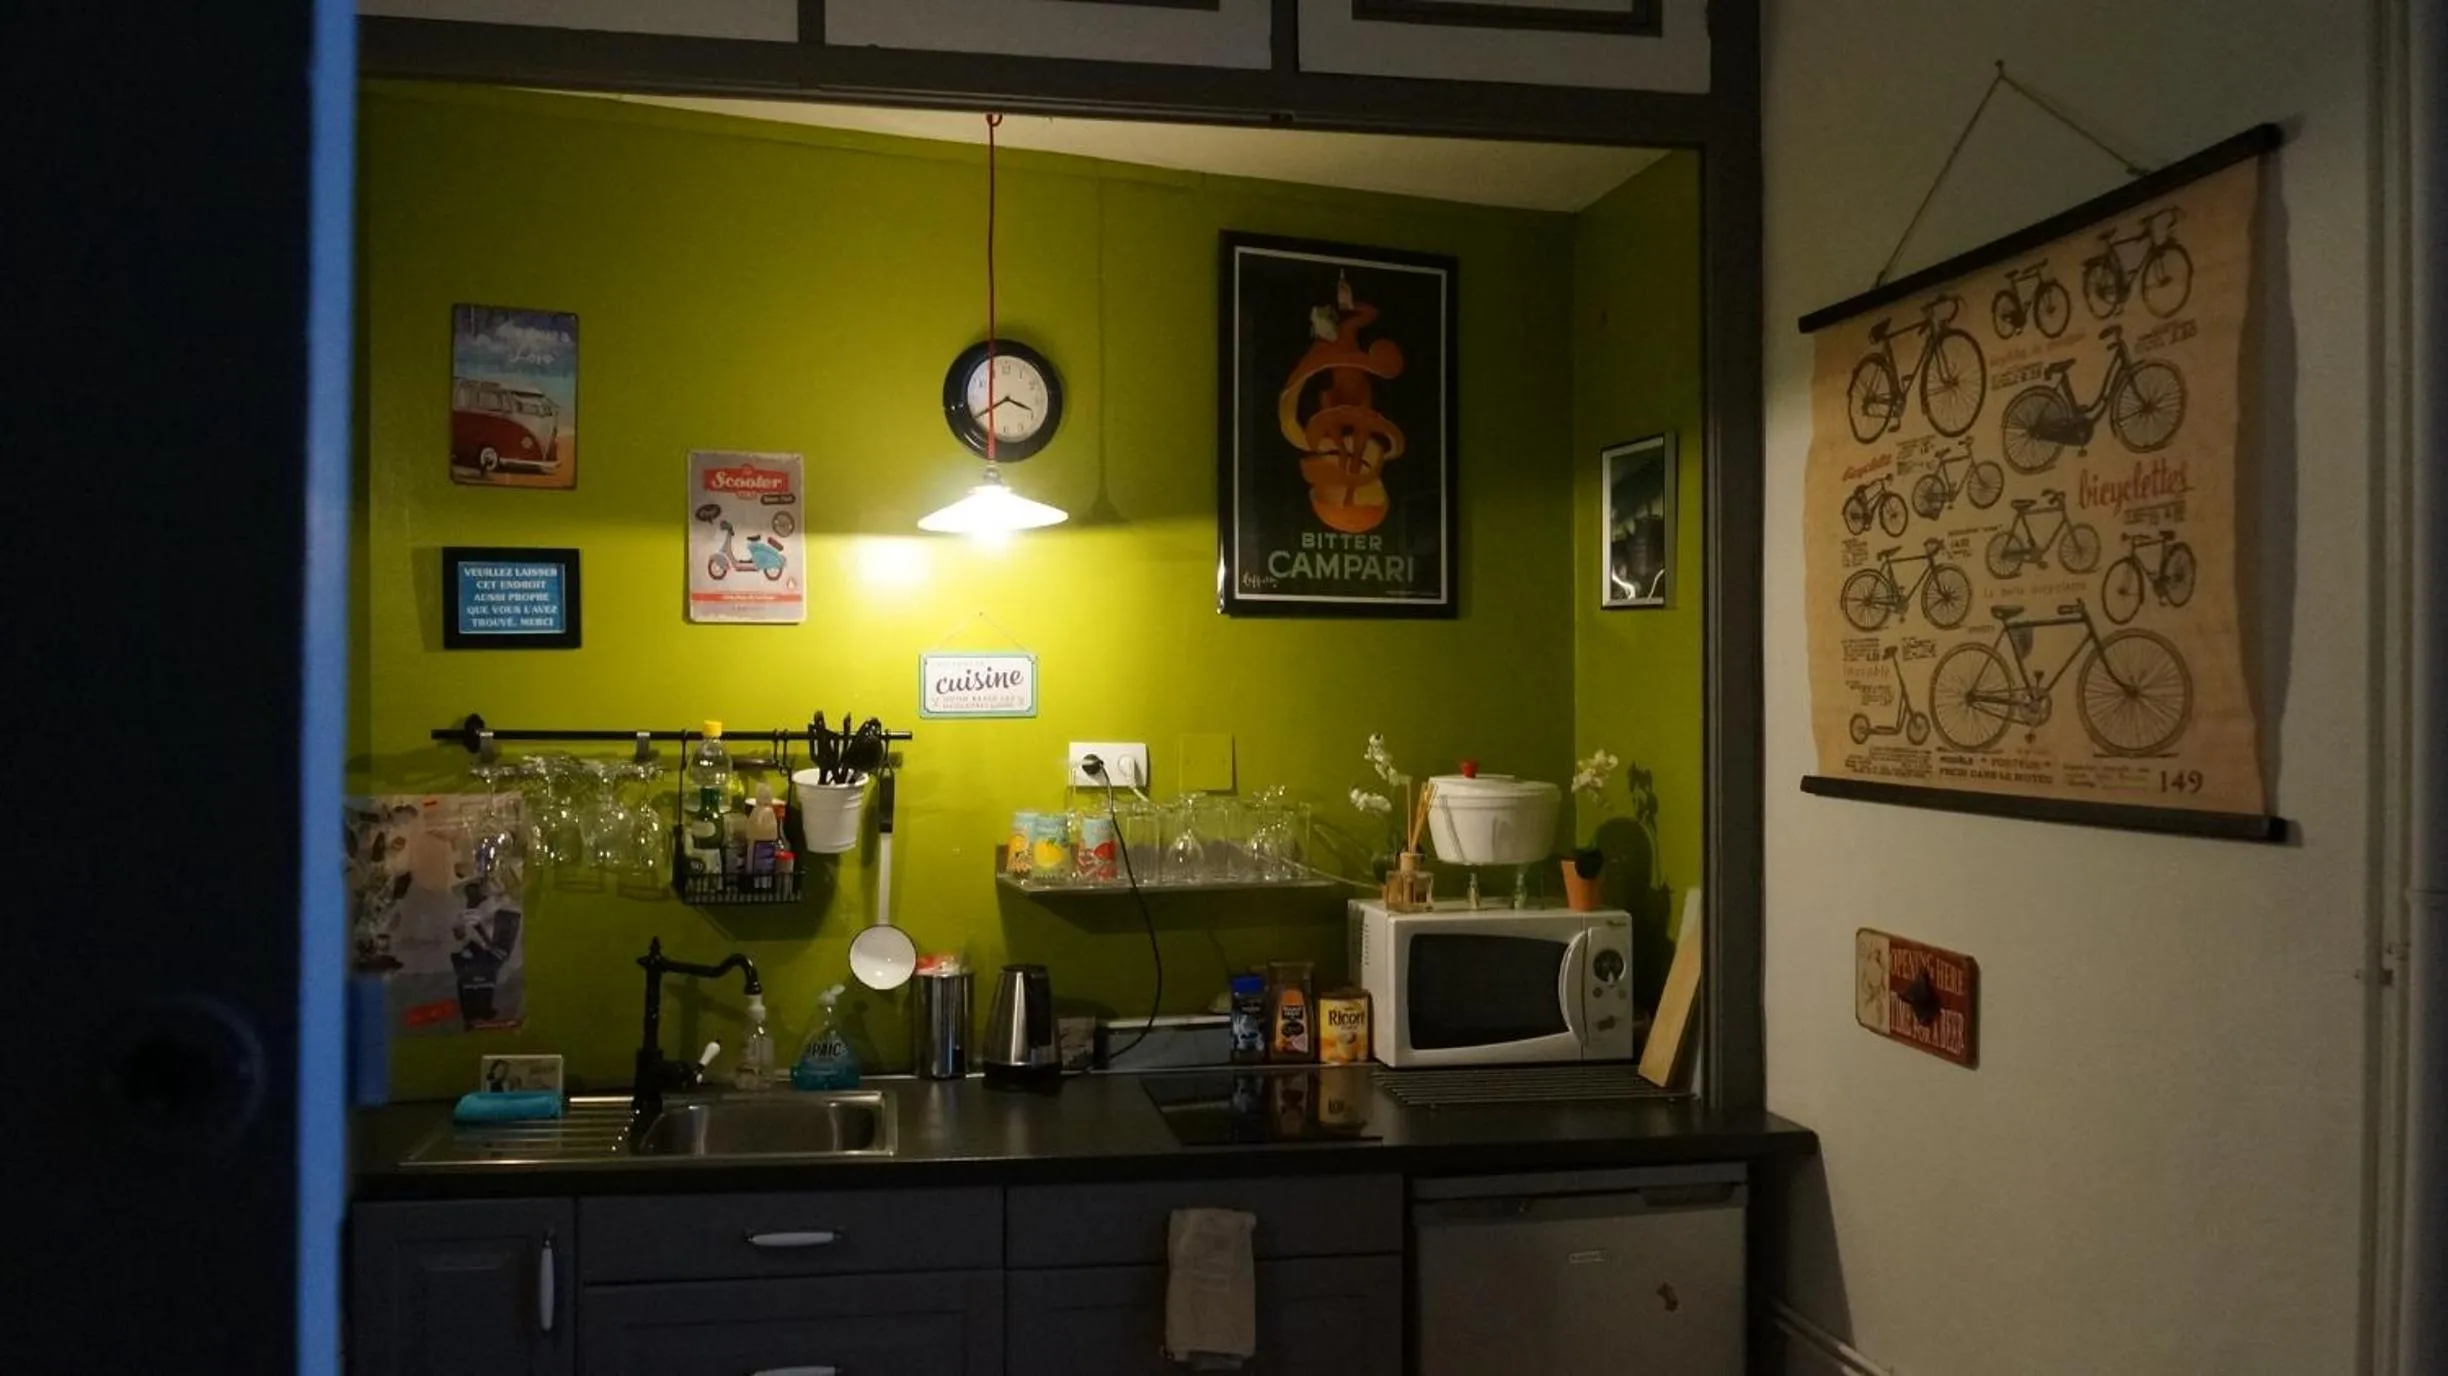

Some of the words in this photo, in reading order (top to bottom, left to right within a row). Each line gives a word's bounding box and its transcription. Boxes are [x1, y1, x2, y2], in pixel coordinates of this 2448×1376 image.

[712, 470, 783, 490] Scooter
[1302, 532, 1383, 551] BITTER
[464, 567, 512, 577] VEUILLEZ
[515, 567, 558, 577] LAISSER
[1268, 550, 1414, 583] CAMPARI
[476, 580, 496, 589] CET
[500, 580, 546, 590] ENDROIT
[474, 592, 505, 602] AUSSI
[508, 592, 550, 602] PROPRE
[466, 605, 488, 616] QUE
[491, 605, 521, 615] VOUS
[523, 605, 558, 615] L'AVEZ
[520, 618, 554, 627] MERCI
[936, 666, 1024, 694] cuisine
[2160, 770, 2204, 794] 149
[1936, 957, 1964, 996] HERE
